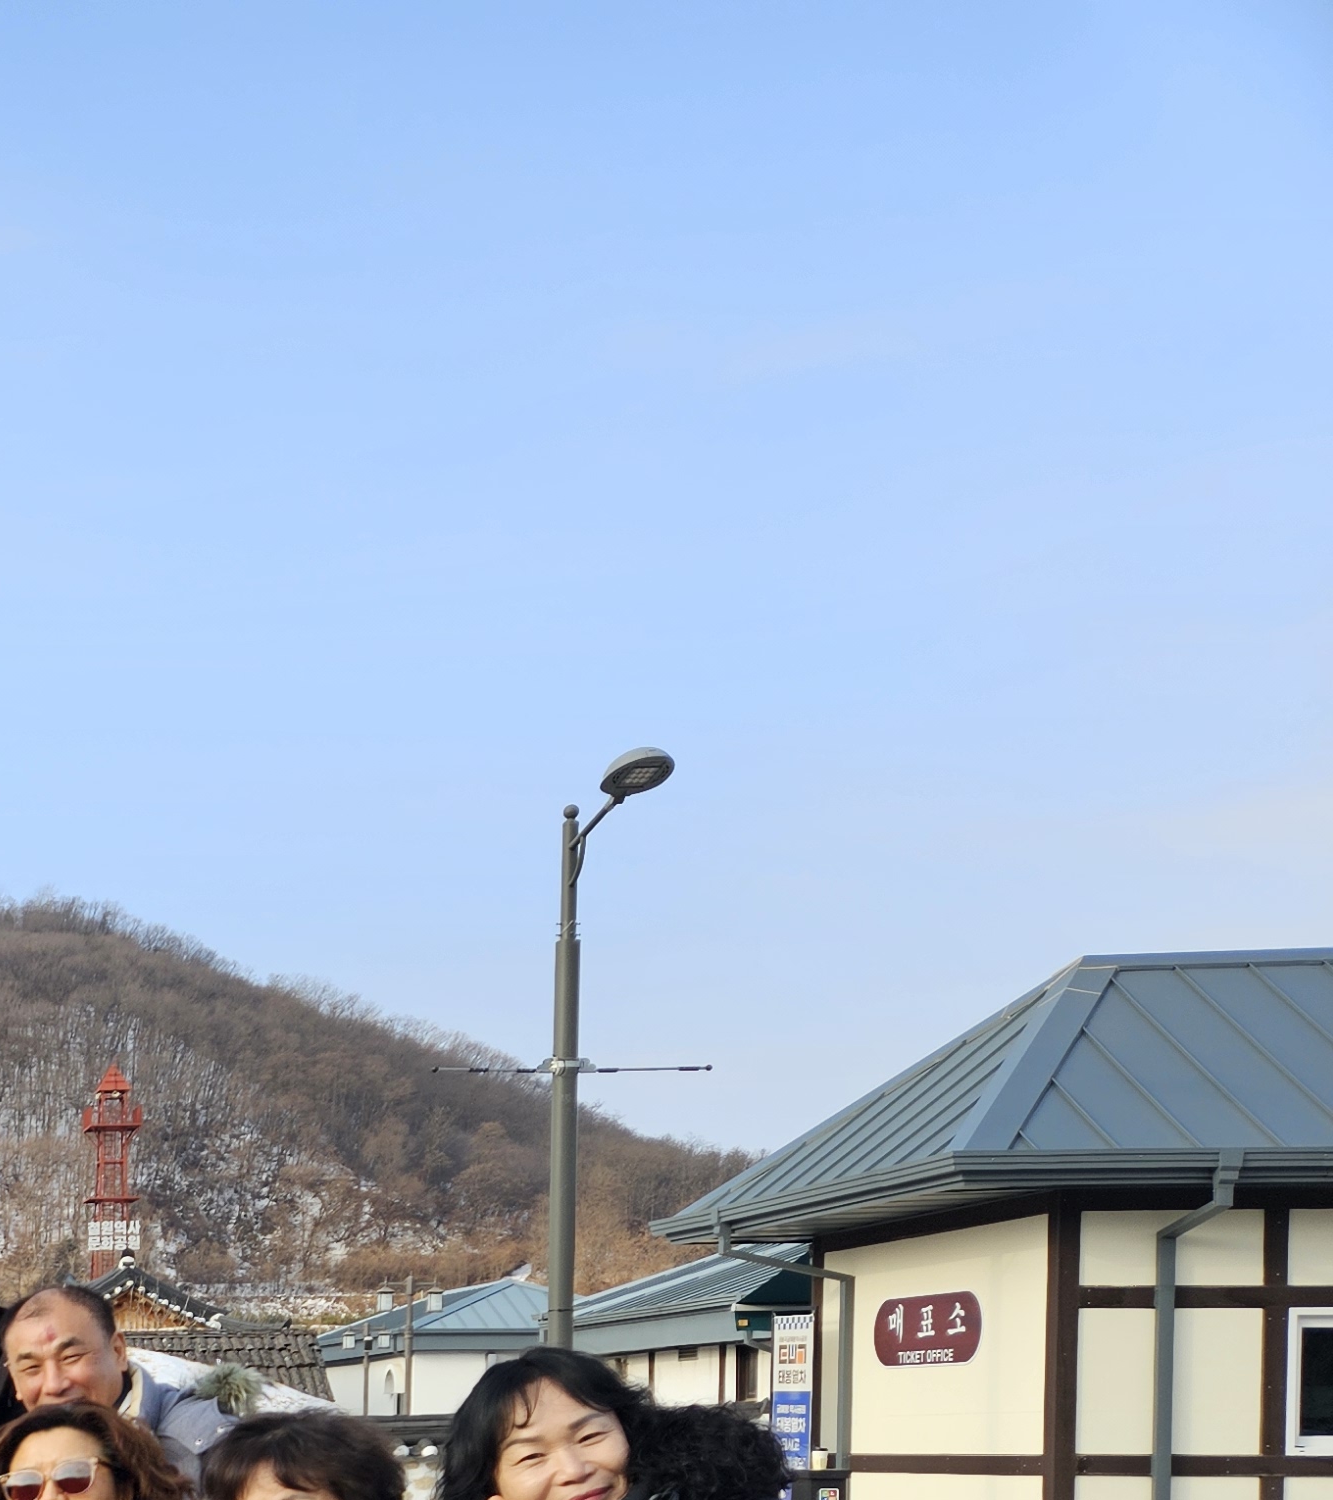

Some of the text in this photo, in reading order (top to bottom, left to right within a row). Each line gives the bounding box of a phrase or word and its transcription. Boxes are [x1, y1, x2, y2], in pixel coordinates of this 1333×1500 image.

[88, 1220, 141, 1235] 철원역사
[88, 1235, 140, 1250] 문화공원
[897, 1348, 954, 1364] TICKET OFFICE
[778, 1369, 806, 1384] 태봉열차
[776, 1417, 806, 1433] 태봉열차
